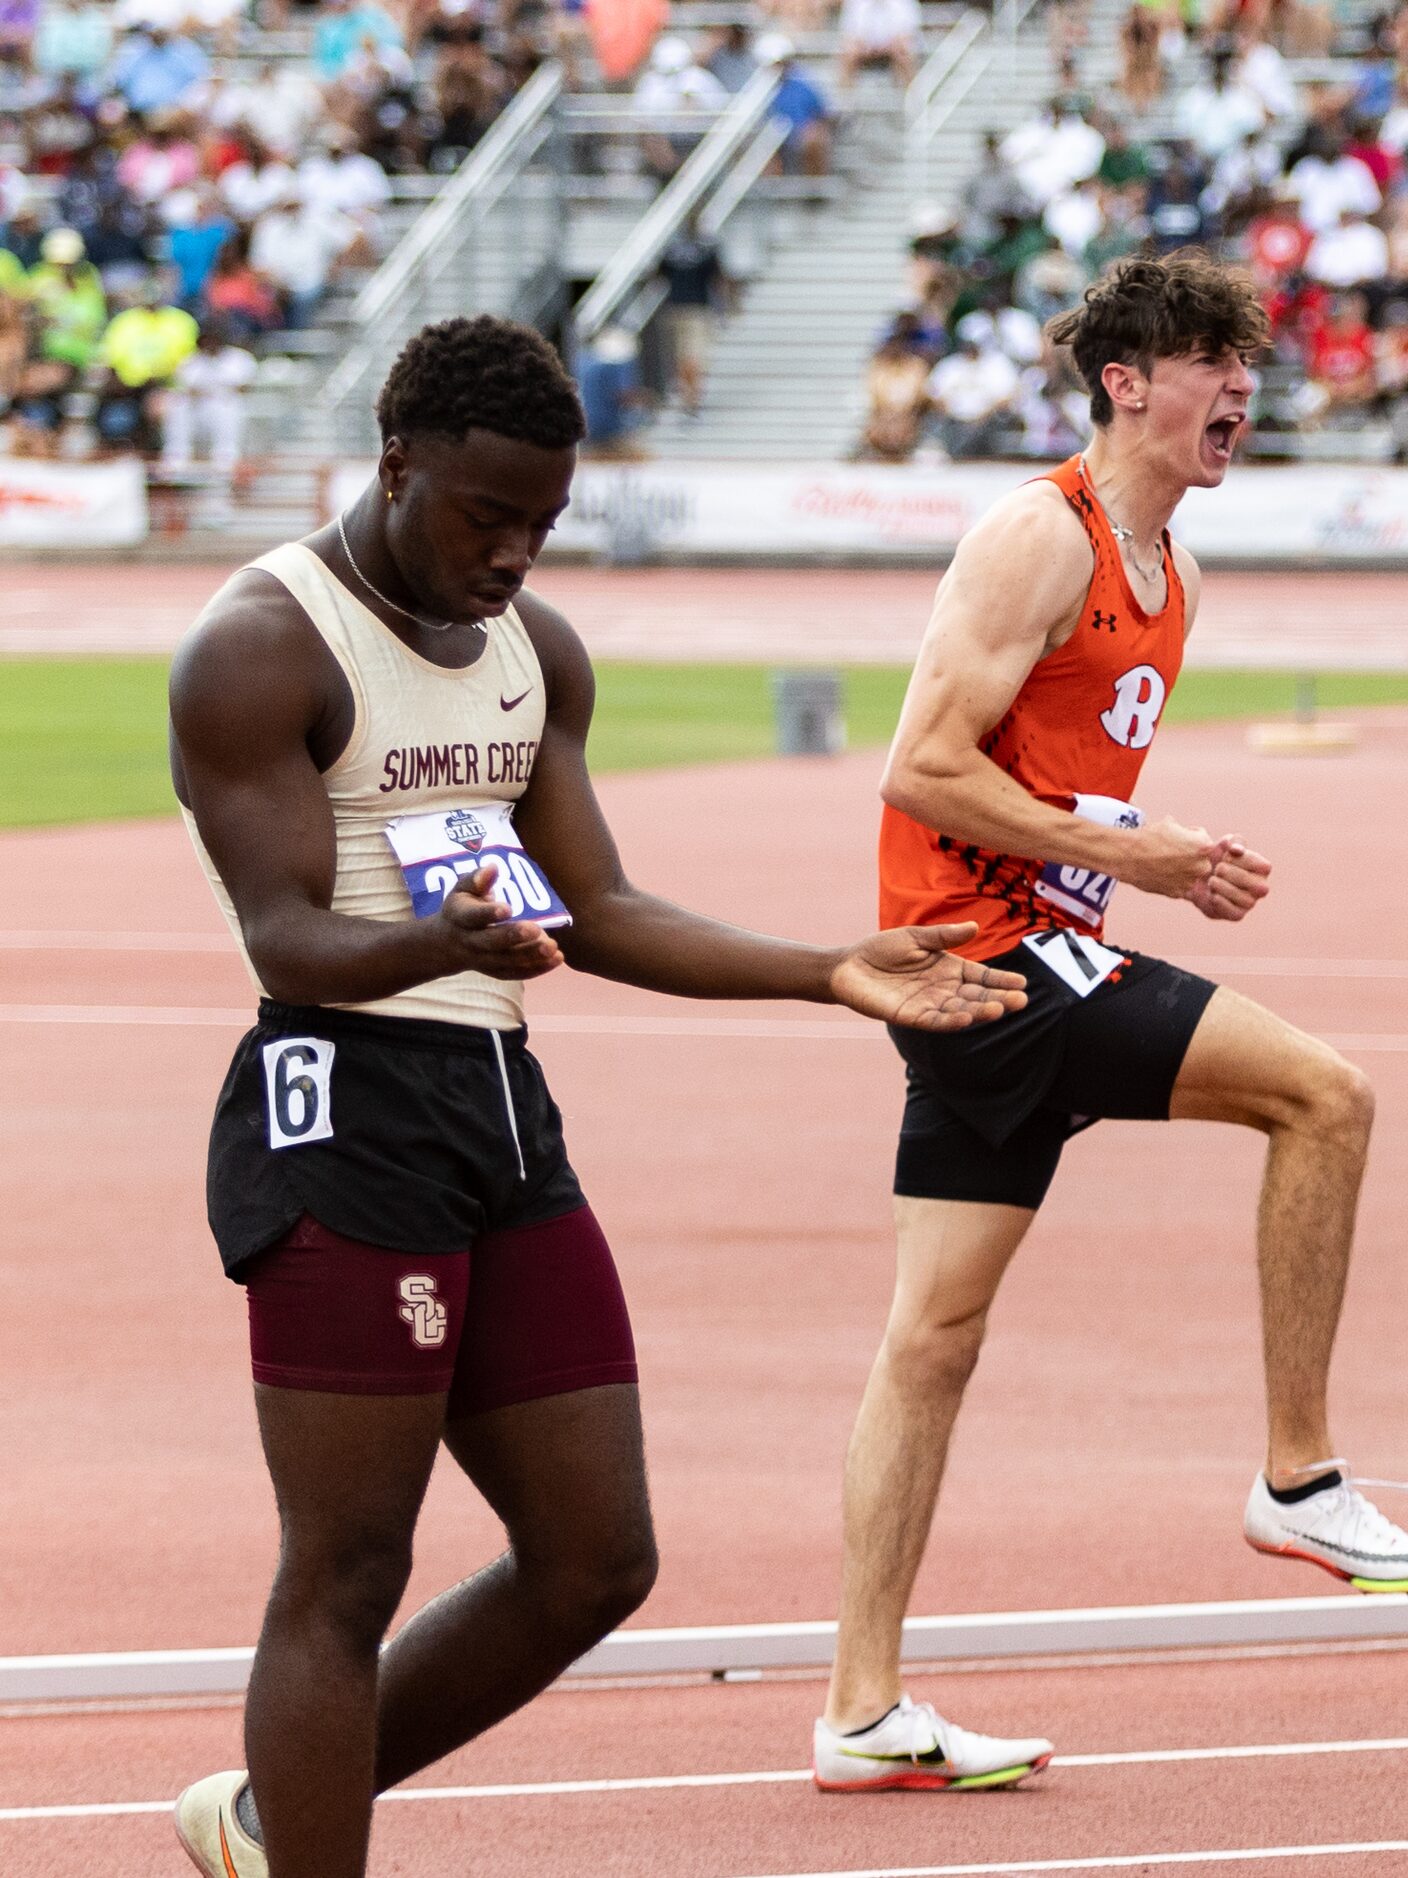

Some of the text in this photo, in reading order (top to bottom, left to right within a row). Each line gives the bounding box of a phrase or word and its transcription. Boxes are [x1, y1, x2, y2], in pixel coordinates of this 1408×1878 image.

[1099, 664, 1165, 750] R
[379, 741, 541, 793] SUMMER CREE
[1033, 926, 1100, 982] 7
[274, 1044, 319, 1138] 6
